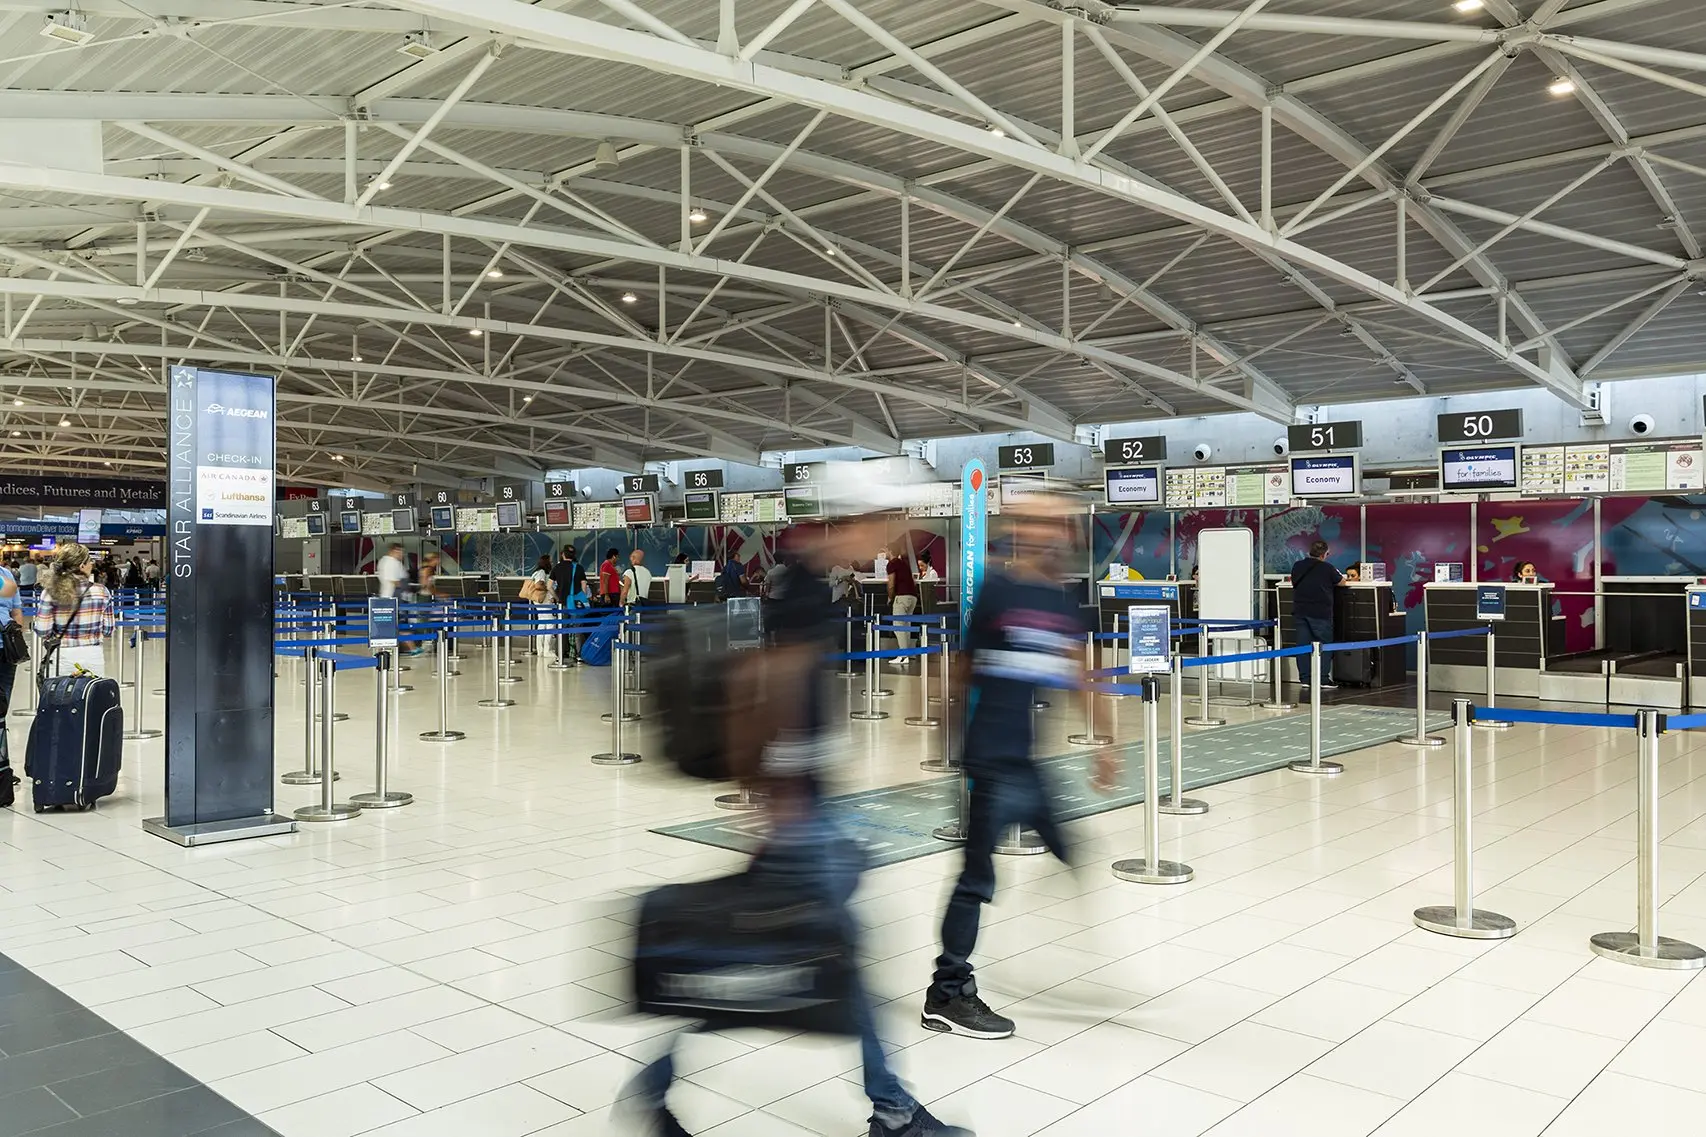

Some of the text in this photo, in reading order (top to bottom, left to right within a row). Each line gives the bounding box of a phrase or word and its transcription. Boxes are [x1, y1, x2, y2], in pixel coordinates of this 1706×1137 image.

[227, 408, 268, 419] AEGEAN
[1463, 415, 1493, 437] 50
[1311, 426, 1334, 447] 51
[1014, 447, 1033, 465] 53
[1122, 441, 1144, 459] 52
[207, 453, 262, 464] CHECK-IN
[201, 472, 257, 481] AIR CANADA
[795, 465, 810, 480] 55
[1457, 467, 1502, 478] for families
[632, 477, 644, 491] 57
[694, 472, 708, 487] 56
[1305, 476, 1341, 484] Economy
[44, 485, 91, 497] Futures
[94, 487, 117, 499] and
[175, 399, 192, 578] STAR ALLIANCE
[503, 487, 513, 499] 59
[552, 484, 563, 496] 58
[1118, 485, 1147, 493] Economy
[221, 492, 266, 502] Lufthansa
[398, 495, 406, 505] 61
[437, 491, 447, 503] 60
[311, 501, 320, 511] 63
[346, 498, 354, 509] 62
[965, 494, 975, 604] AEGEAN for families
